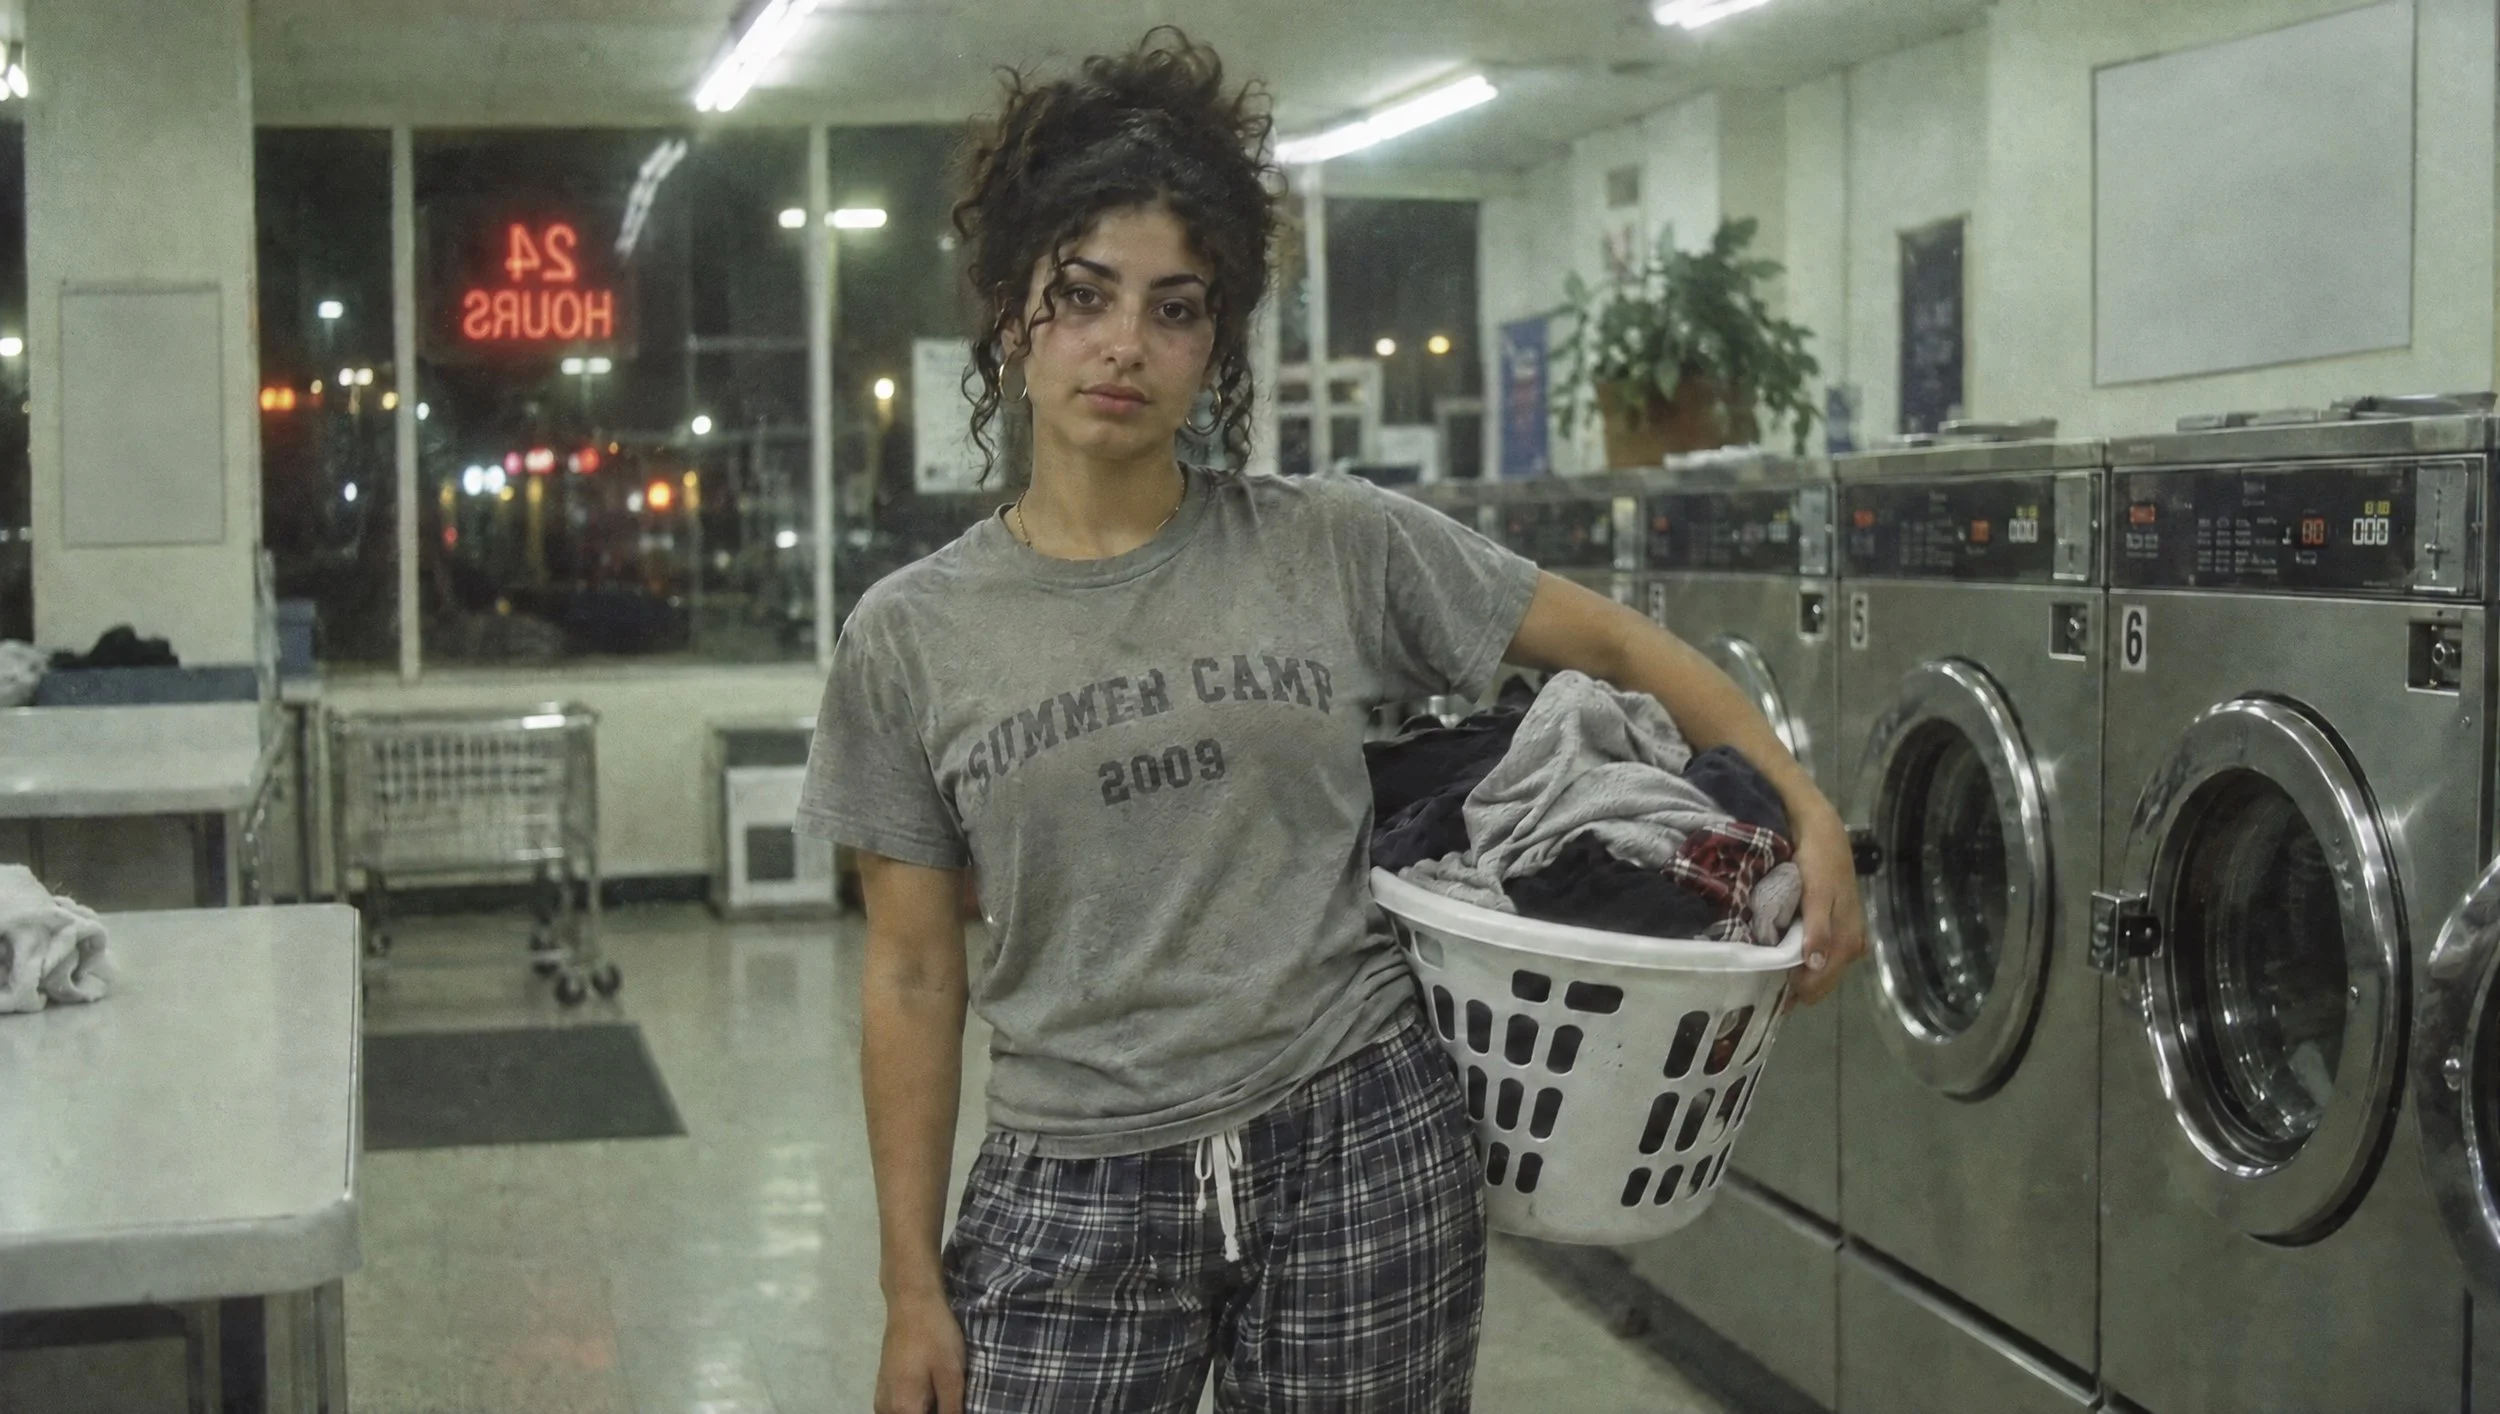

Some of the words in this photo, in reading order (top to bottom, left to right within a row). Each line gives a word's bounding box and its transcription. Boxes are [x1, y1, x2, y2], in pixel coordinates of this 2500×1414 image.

[2126, 609, 2143, 666] 6
[968, 668, 1174, 793] SUMMER
[1192, 654, 1332, 715] CAMP
[1099, 738, 1225, 807] 2009
